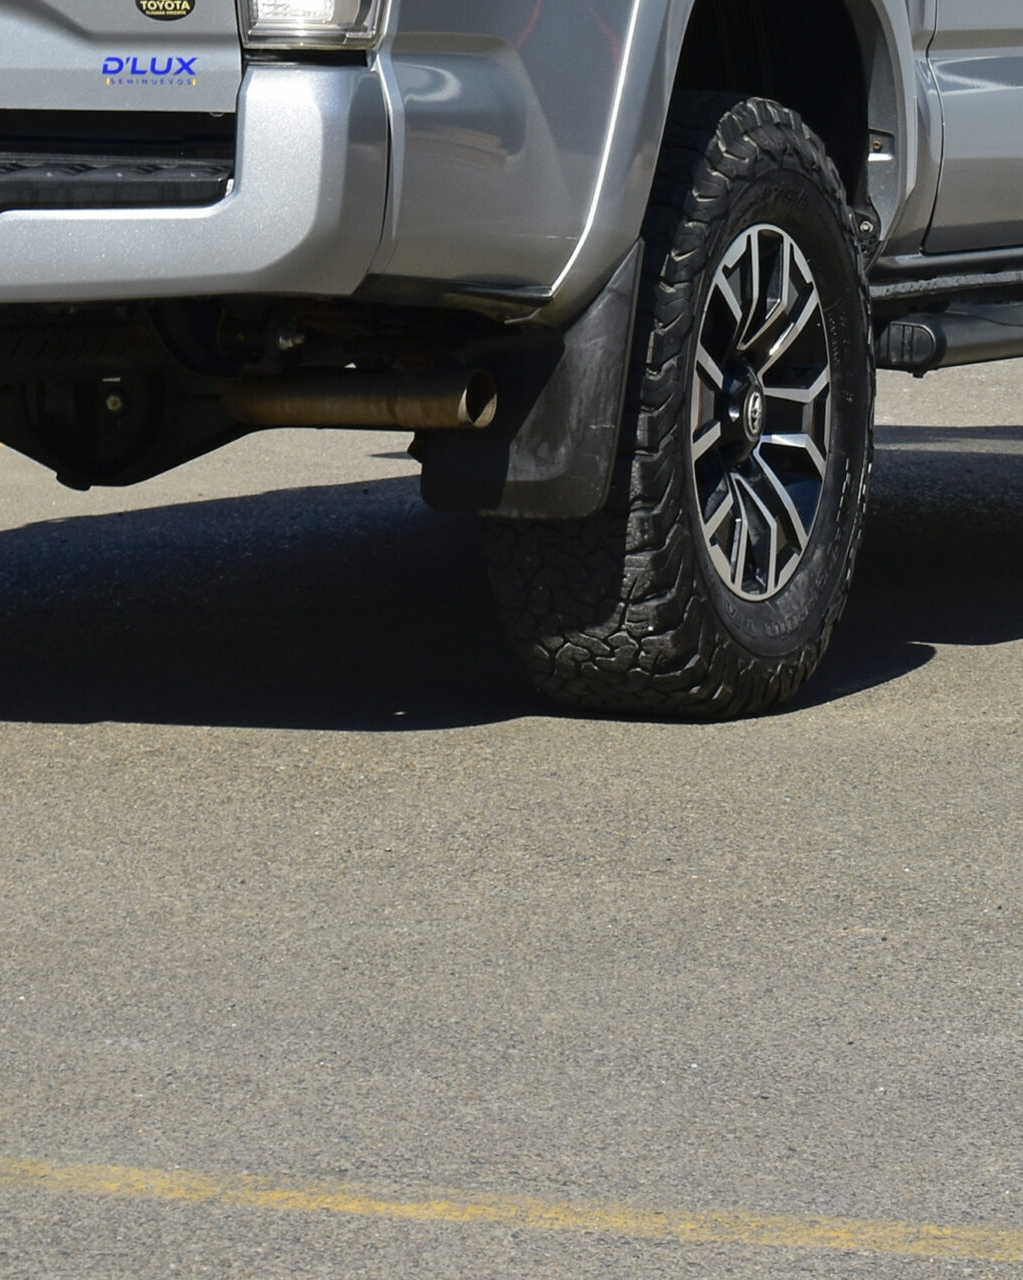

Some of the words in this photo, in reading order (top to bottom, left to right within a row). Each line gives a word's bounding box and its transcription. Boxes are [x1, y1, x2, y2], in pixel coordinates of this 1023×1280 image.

[139, 0, 191, 11] TOYOTA
[102, 56, 198, 75] D'LUX
[109, 77, 192, 86] SEMINUEVOS
